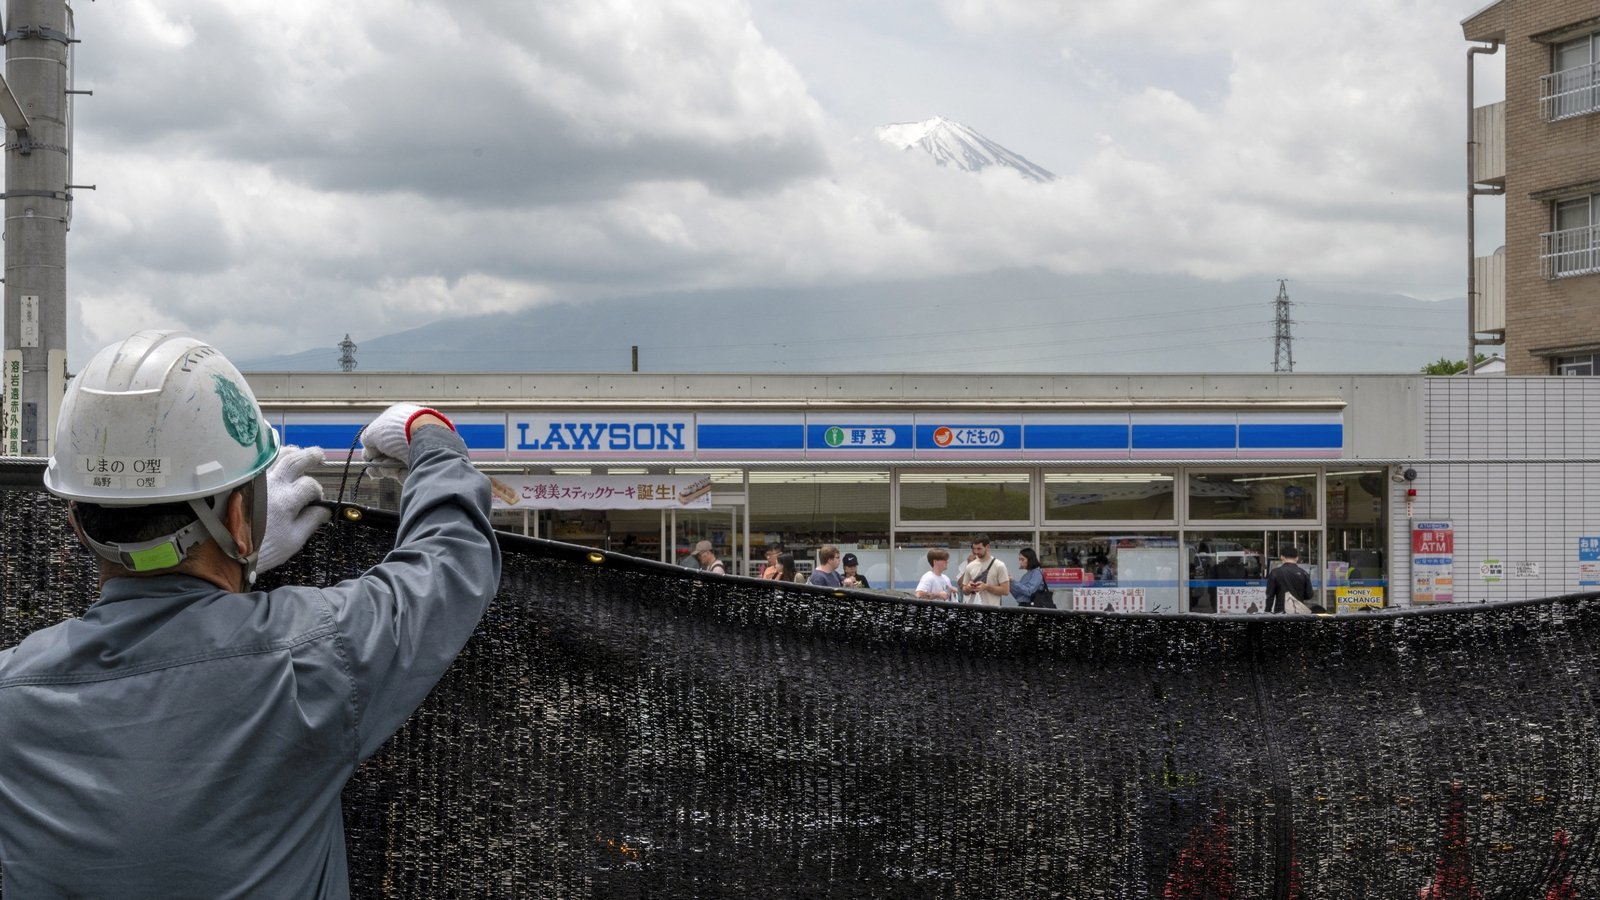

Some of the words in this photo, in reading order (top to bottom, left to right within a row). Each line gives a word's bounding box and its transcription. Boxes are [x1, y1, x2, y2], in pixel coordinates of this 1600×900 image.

[9, 360, 20, 456] 溶岩遠赤外線風
[517, 423, 685, 450] LAWSON
[851, 429, 887, 444] 野菜
[955, 429, 1000, 444] くだもの
[86, 457, 125, 473] しまの
[1420, 542, 1446, 552] ATM
[1337, 596, 1381, 604] EXCHANGE
